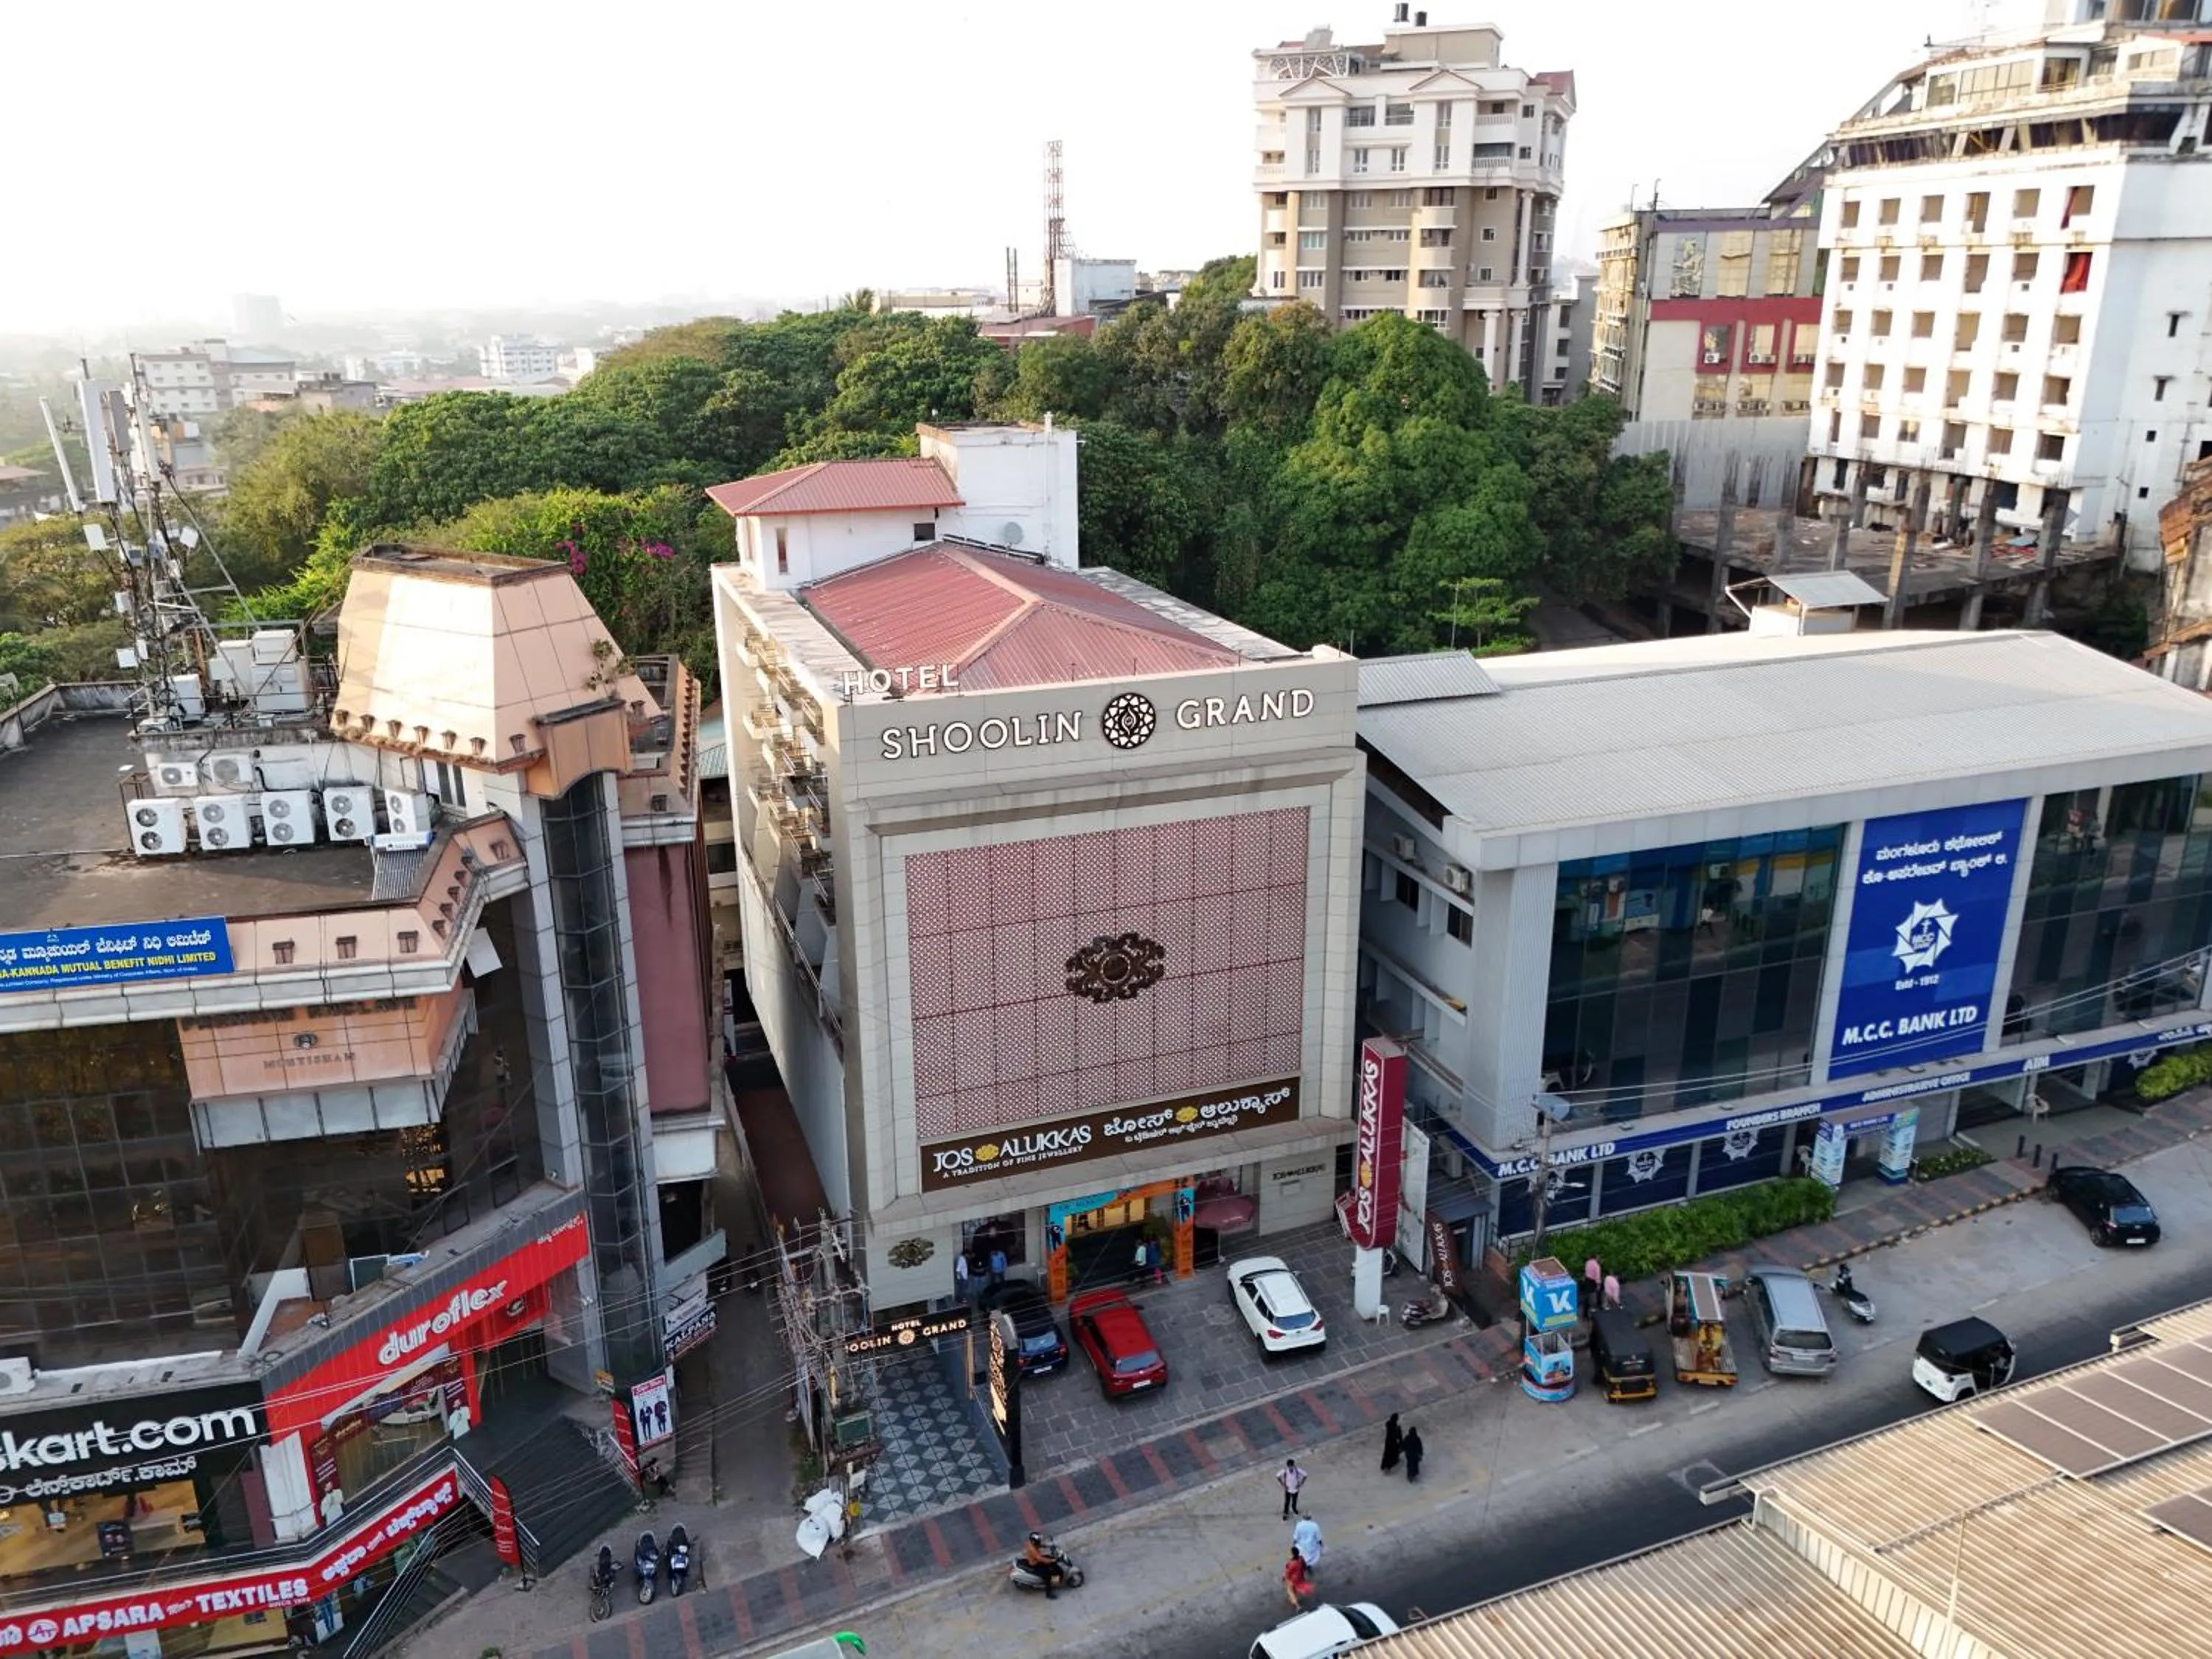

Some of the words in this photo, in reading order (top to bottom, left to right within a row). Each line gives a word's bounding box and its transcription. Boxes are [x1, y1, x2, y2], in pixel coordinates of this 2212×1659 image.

[843, 664, 959, 695] HOTEL
[881, 710, 1084, 760] SHOOLIN
[1175, 688, 1315, 730] GRAND
[0, 964, 60, 979] A-KANNADA
[60, 960, 102, 974] MUTUAL
[103, 958, 145, 970] BENEFIT
[147, 954, 175, 967] NIDHI
[176, 951, 216, 964] LIMITED
[1841, 1021, 1893, 1046] M.C.C.
[1897, 1009, 1947, 1036] BANK
[1949, 1005, 1978, 1026] LTD
[1360, 1059, 1379, 1166] ALUKKAS
[933, 1147, 974, 1172] JOS
[999, 1124, 1092, 1158] ALUKKAS
[942, 1171, 950, 1179] A
[951, 1161, 1000, 1178] TRADITION
[1002, 1158, 1014, 1168] OF
[1017, 1155, 1036, 1164] FINE
[1038, 1145, 1084, 1161] JEWELLERY
[1590, 1142, 1616, 1159] LTD
[1357, 1186, 1373, 1236] JOS
[378, 1279, 508, 1365] duroflex
[891, 1319, 922, 1332] HOTEL
[922, 1319, 967, 1336] GRAND
[0, 1408, 257, 1472] kart.com
[63, 1601, 166, 1638] APSARA
[195, 1578, 309, 1613] TEXTILES
